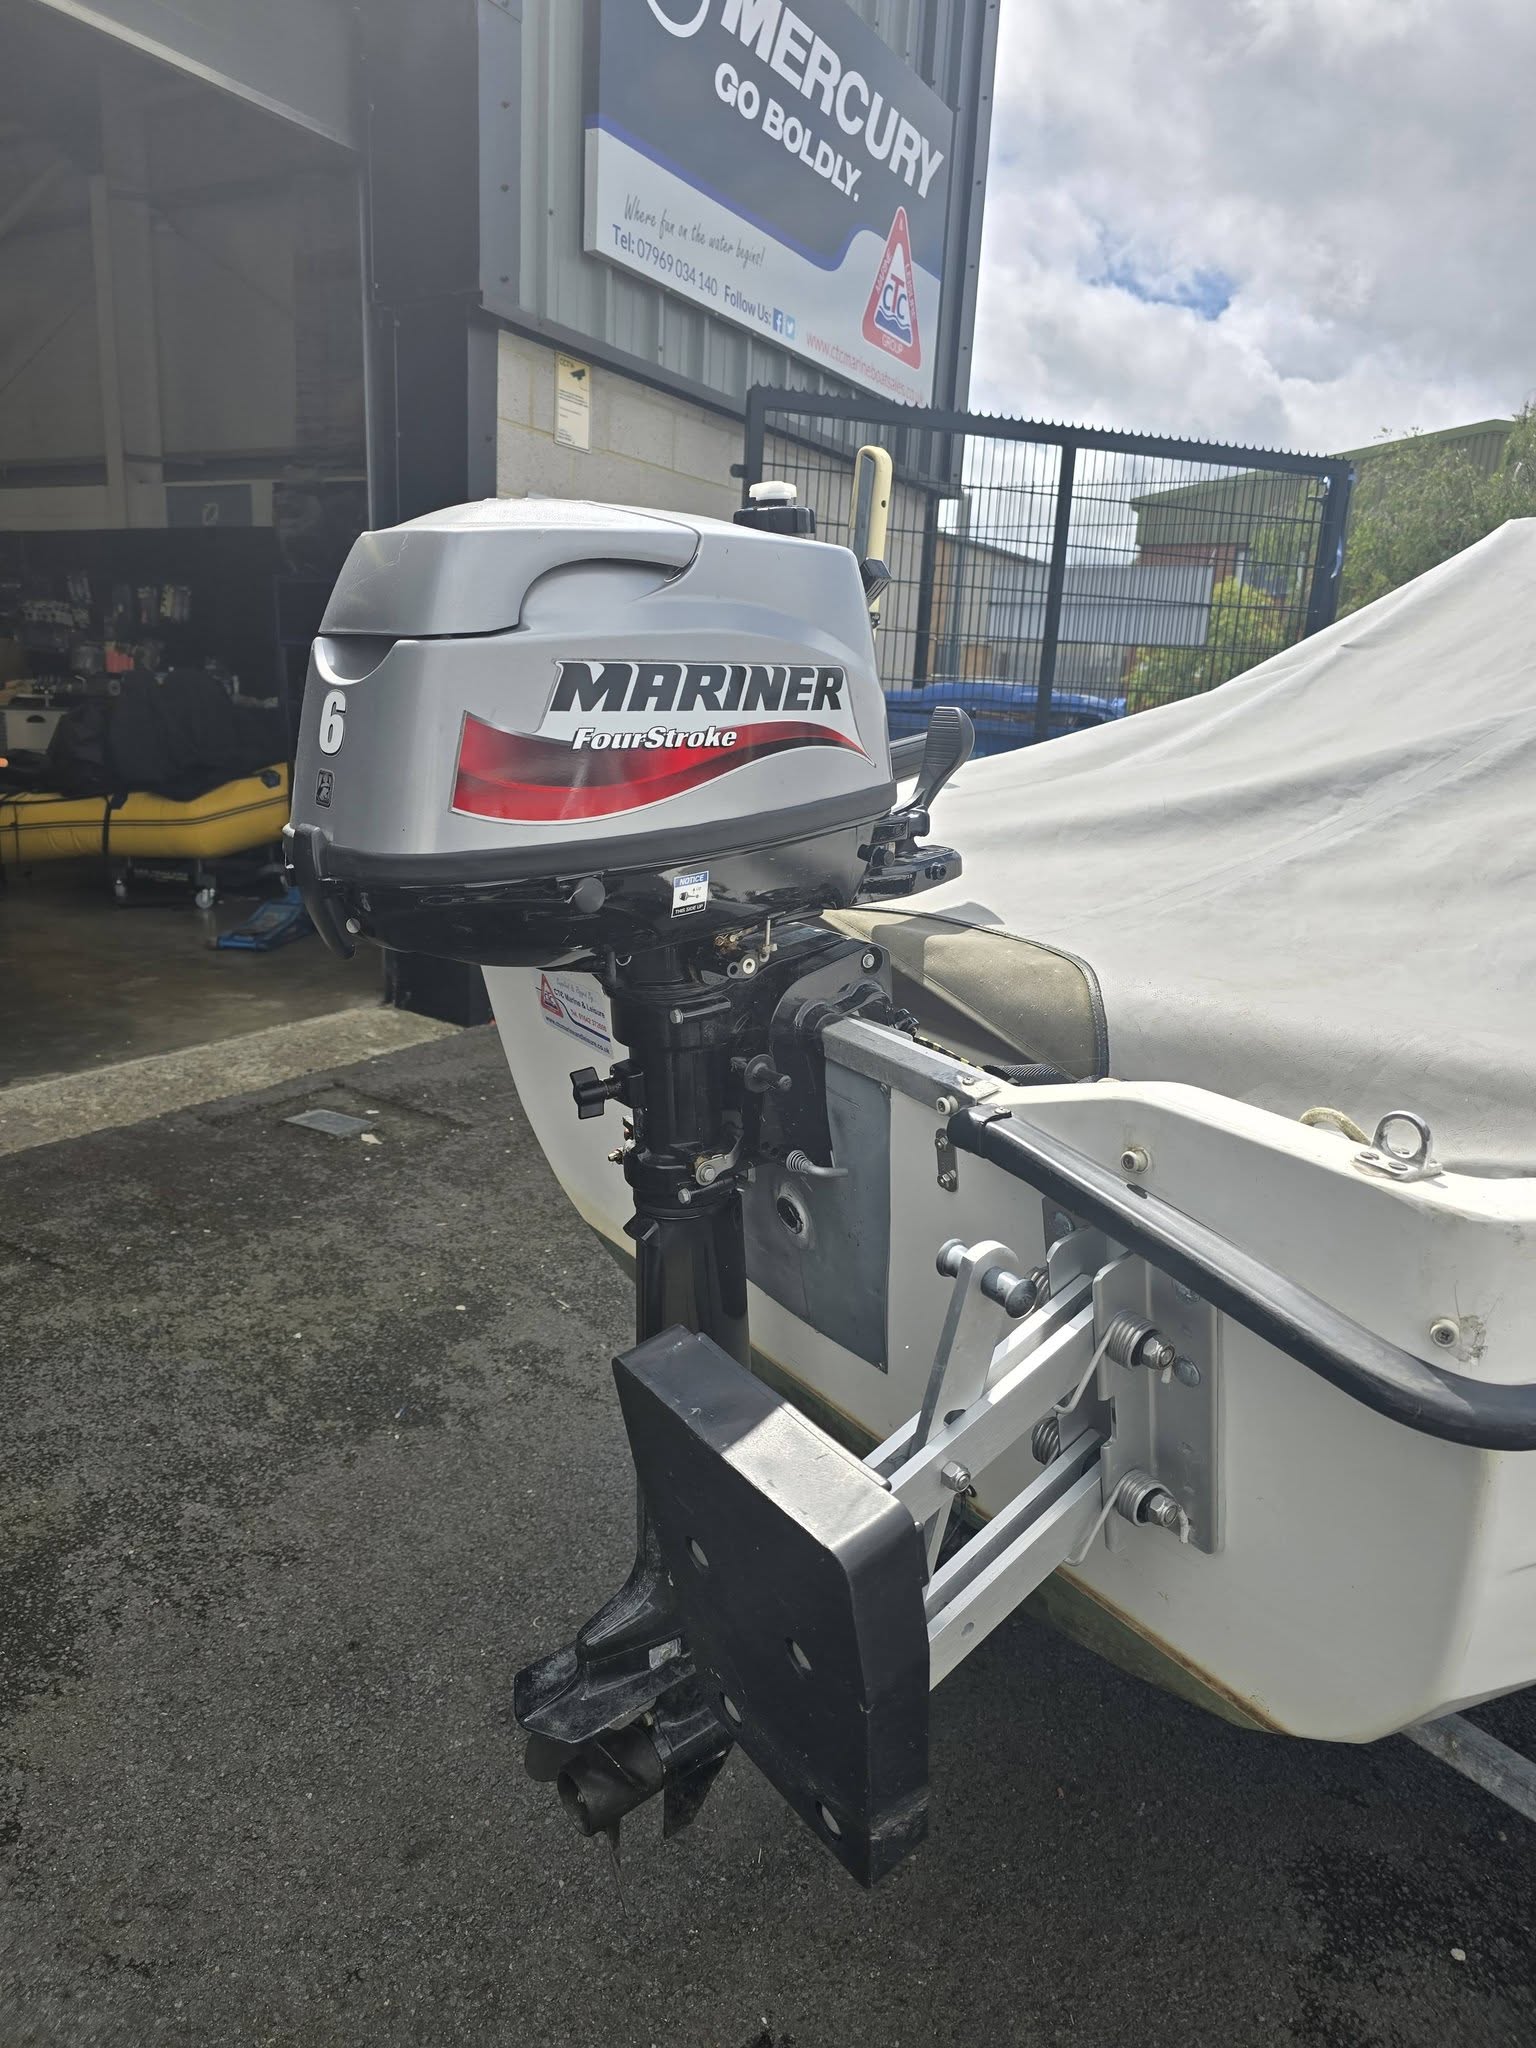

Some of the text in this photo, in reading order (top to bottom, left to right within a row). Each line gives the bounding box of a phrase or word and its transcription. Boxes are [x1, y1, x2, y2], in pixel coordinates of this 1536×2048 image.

[720, 0, 944, 198] MERCURY
[714, 62, 862, 202] GO BOLDLY.
[624, 194, 657, 227] Where
[658, 209, 675, 240] fun
[691, 223, 706, 243] the
[709, 235, 733, 253] water
[735, 240, 766, 270] begins!
[612, 224, 772, 325] Tel: 07969 034 140 Follow Us:
[882, 273, 907, 320] CTC
[549, 662, 843, 712] MARINER
[319, 689, 347, 756] 6
[571, 726, 738, 751] FourStroke
[680, 874, 705, 886] NOTICE
[675, 907, 685, 915] THIS
